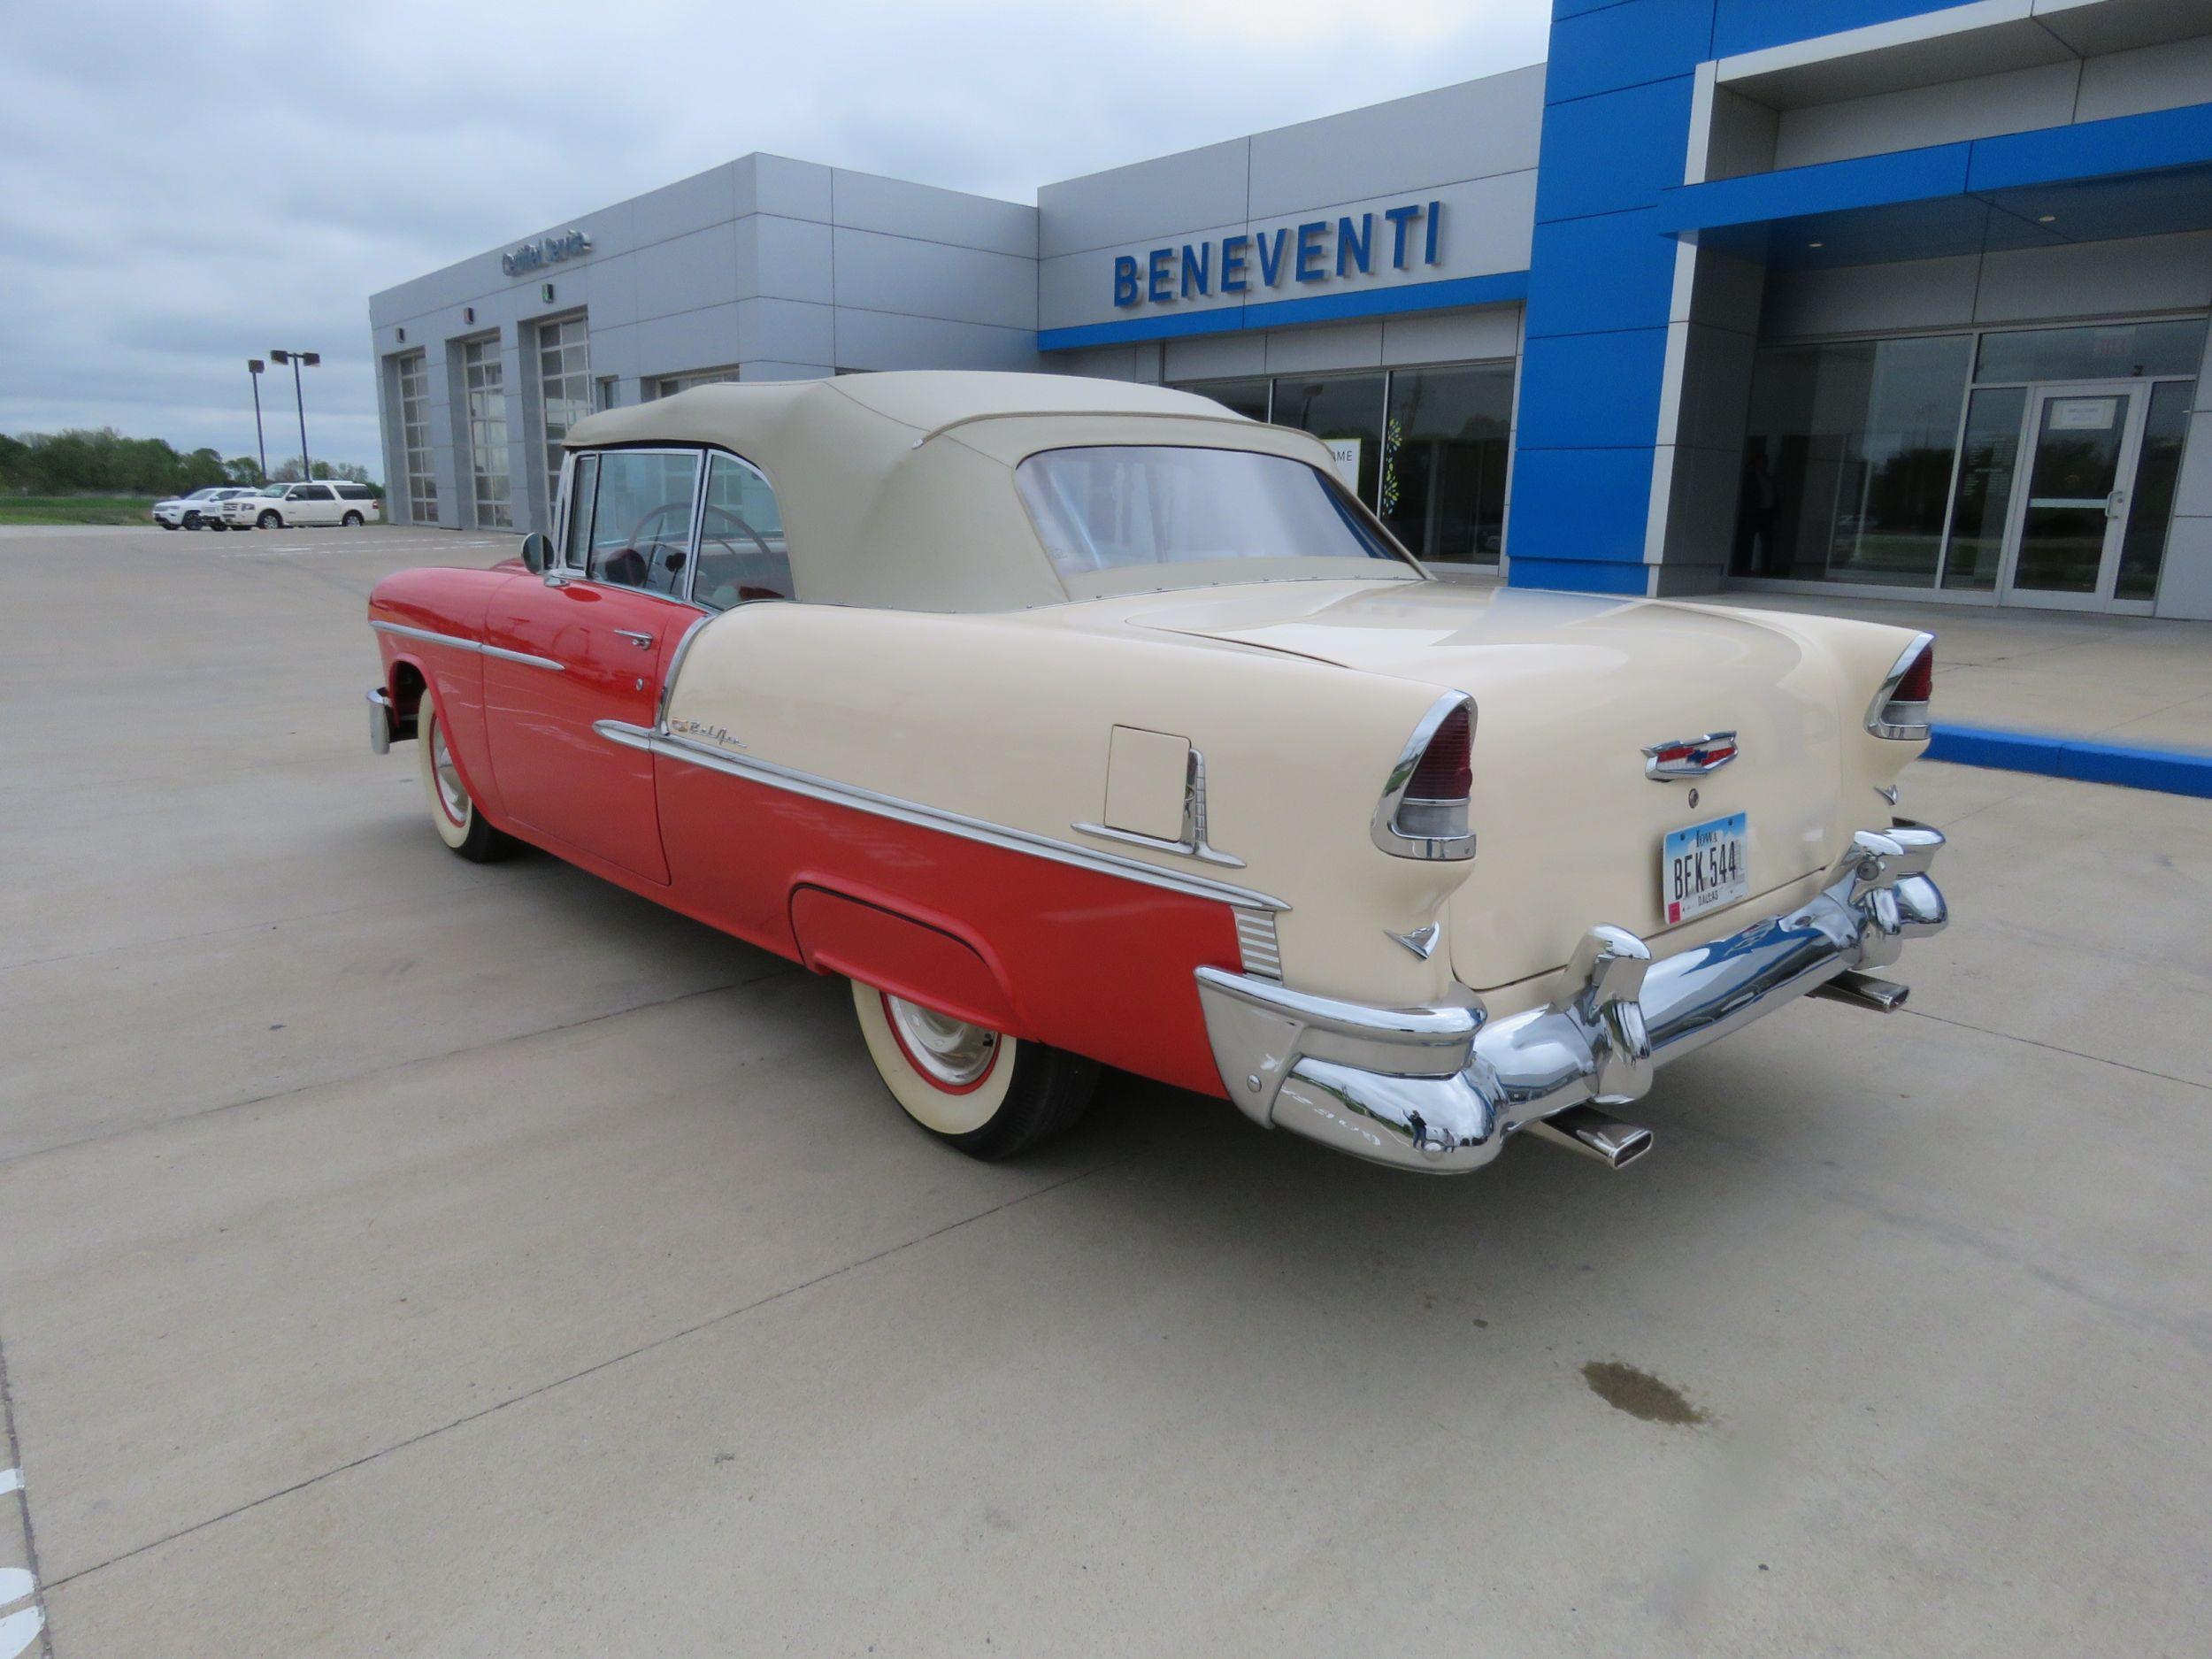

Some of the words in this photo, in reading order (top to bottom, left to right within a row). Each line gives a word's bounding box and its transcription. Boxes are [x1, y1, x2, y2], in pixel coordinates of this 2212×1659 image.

[1114, 200, 1442, 307] BENEVENTI
[1674, 851, 1704, 900] BFK
[1709, 841, 1736, 887] 544
